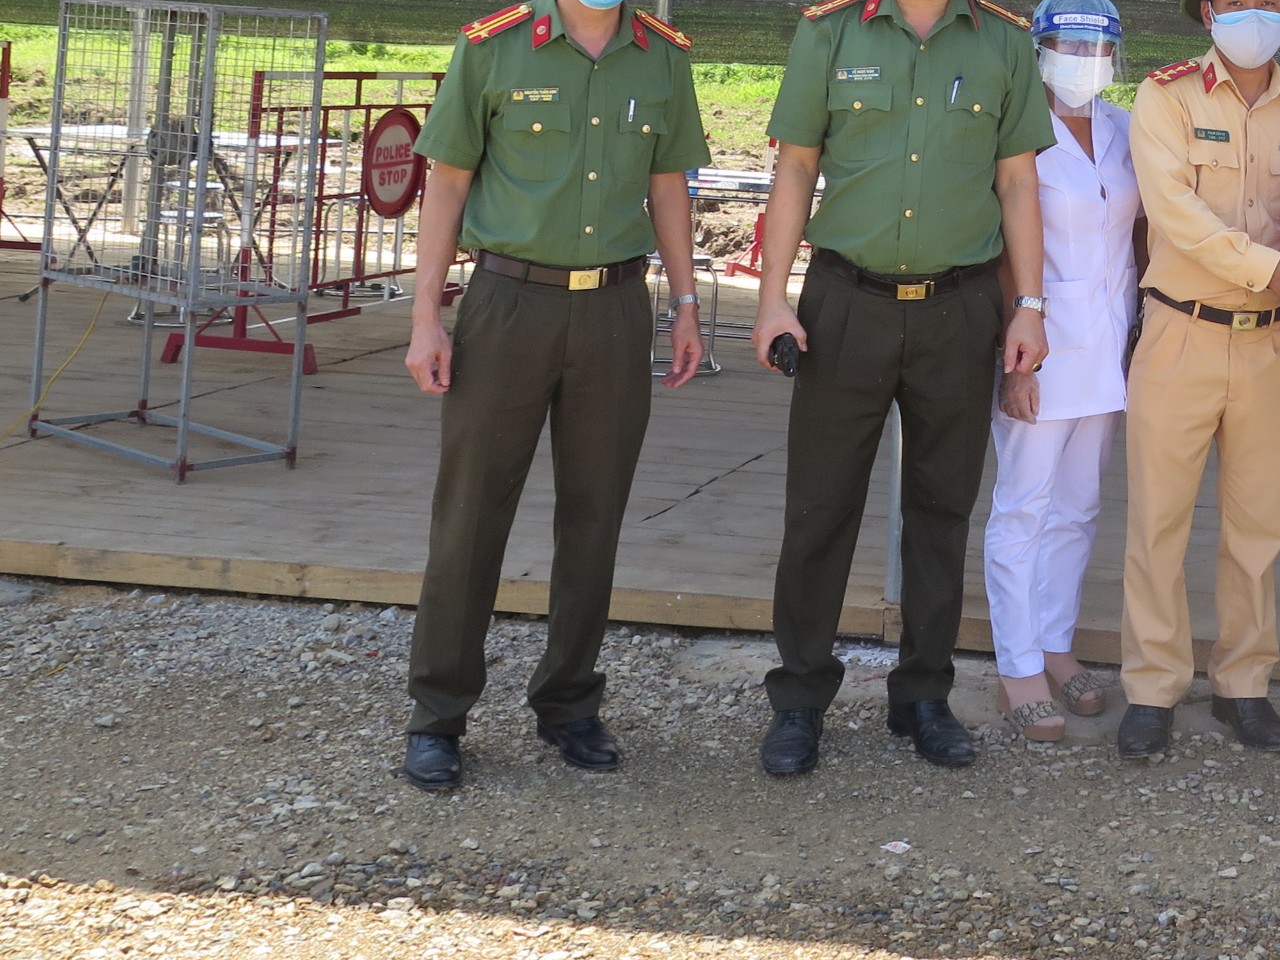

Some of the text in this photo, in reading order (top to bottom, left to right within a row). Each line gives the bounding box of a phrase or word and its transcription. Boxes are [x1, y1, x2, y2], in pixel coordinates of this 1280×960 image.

[1058, 15, 1105, 24] Face Shield
[375, 143, 412, 161] POLICE
[378, 169, 407, 186] STOP
